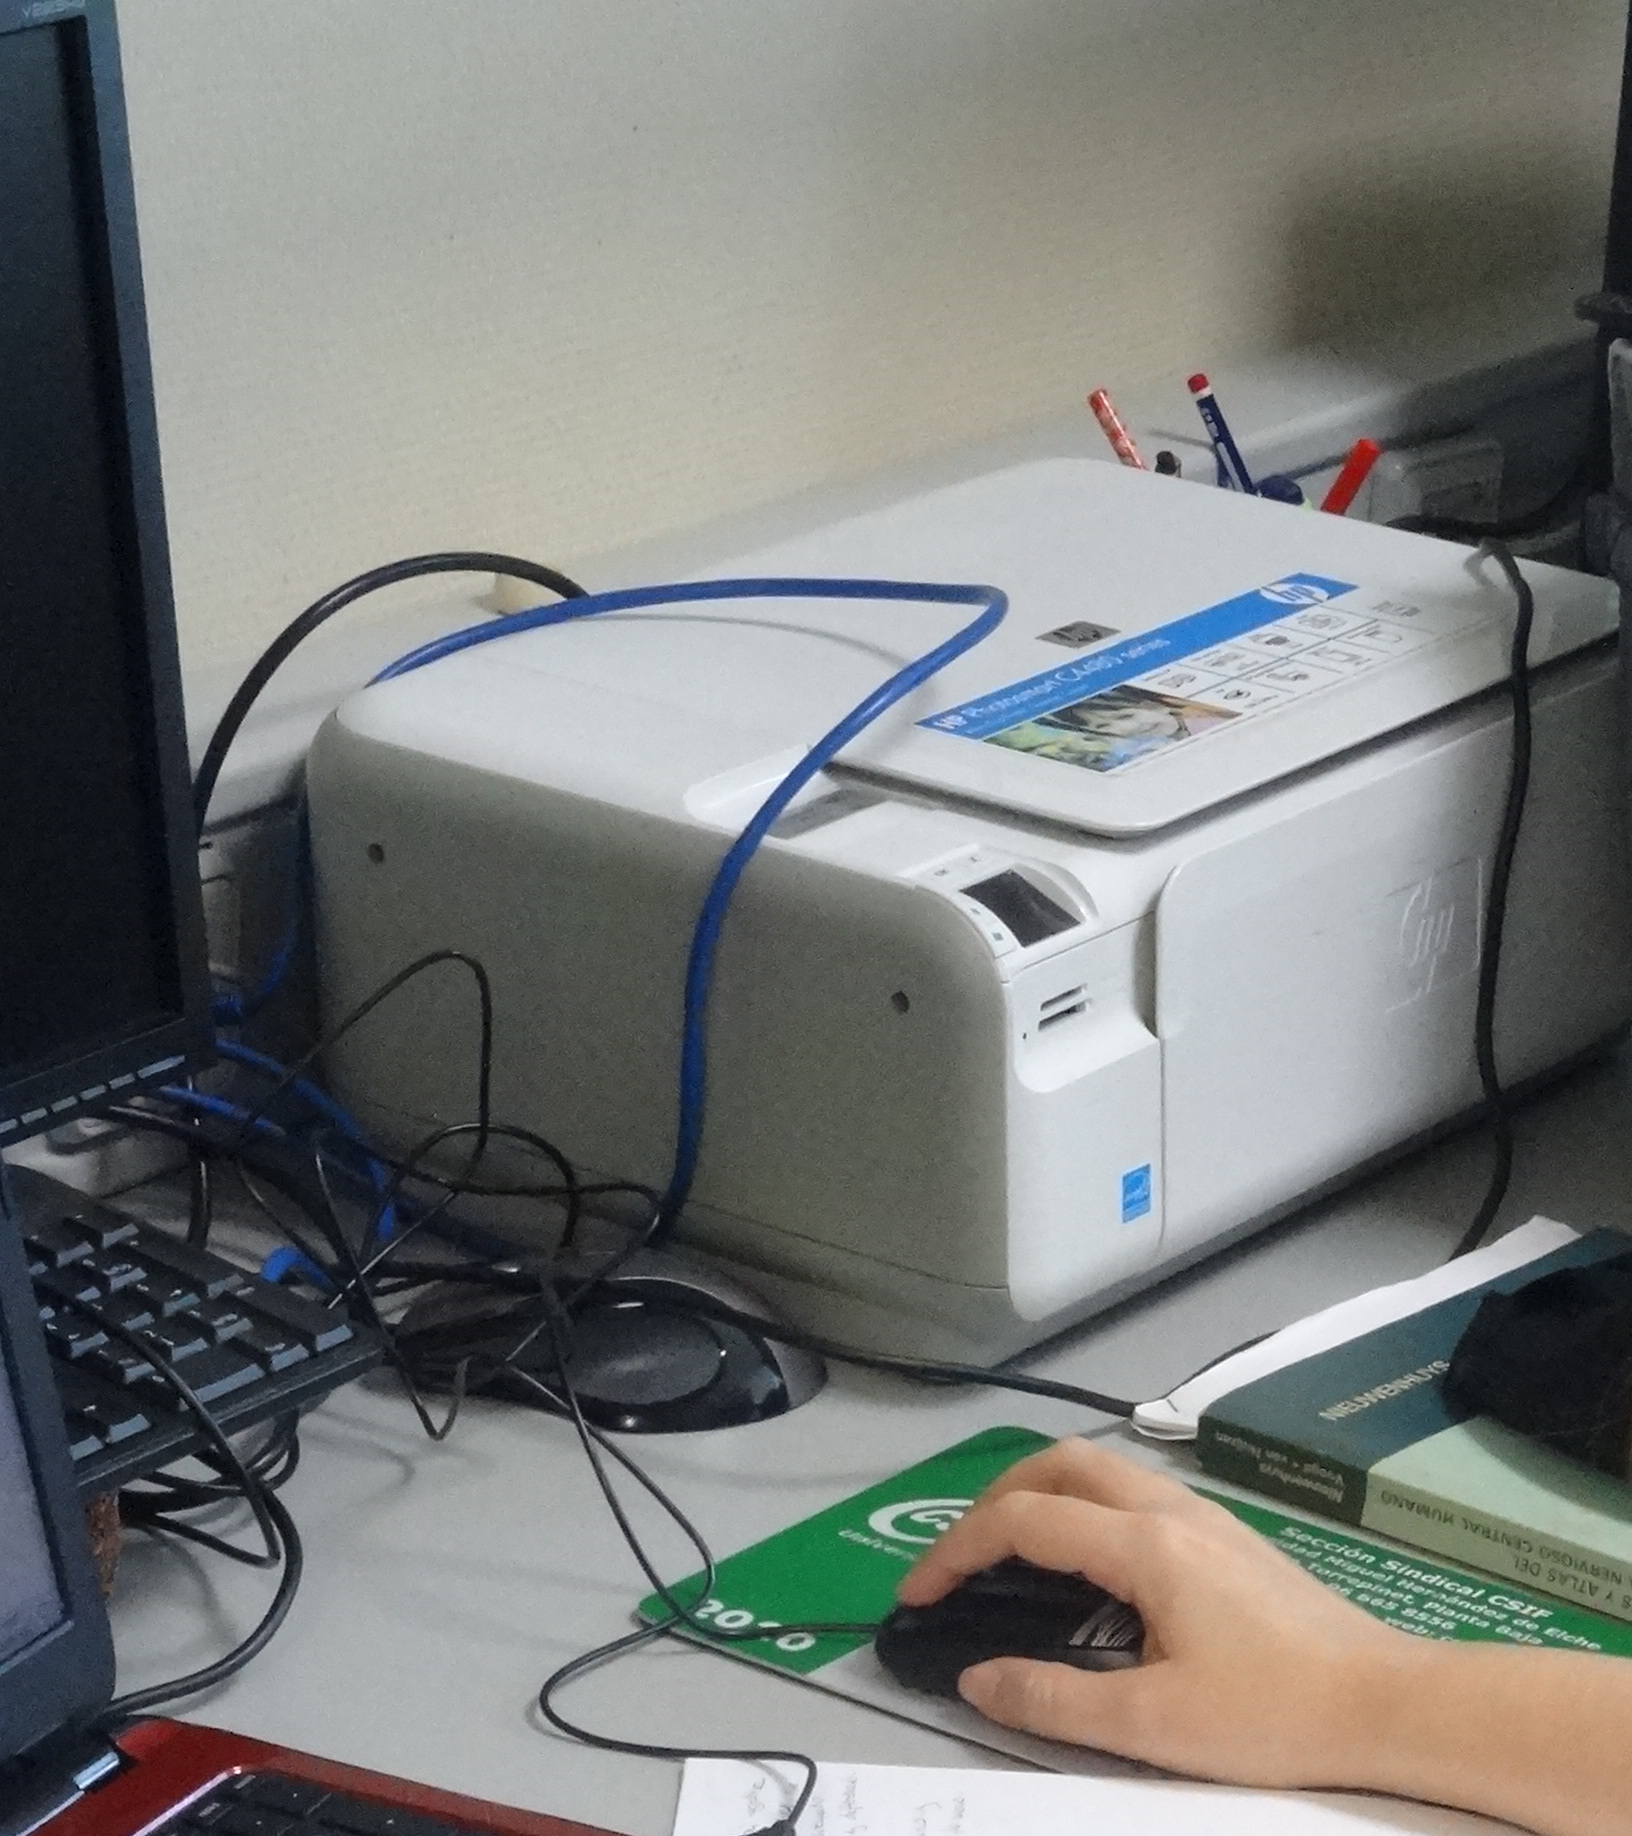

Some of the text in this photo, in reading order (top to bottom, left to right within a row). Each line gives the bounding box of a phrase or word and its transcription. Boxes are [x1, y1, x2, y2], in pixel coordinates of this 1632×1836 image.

[1319, 1359, 1450, 1422] NIEUWENHUYS
[1380, 1489, 1455, 1526] HUMANO
[1461, 1518, 1534, 1554] CENTRAL
[1280, 1526, 1555, 1619] Sección Sindical CSIF
[1513, 1556, 1542, 1577] DEL
[1538, 1544, 1623, 1586] NERVIOSO
[1547, 1567, 1600, 1598] ATLAS
[1324, 1555, 1395, 1583] Miguel
[1543, 1627, 1602, 1651] Elche
[1422, 1600, 1491, 1629] Planta
